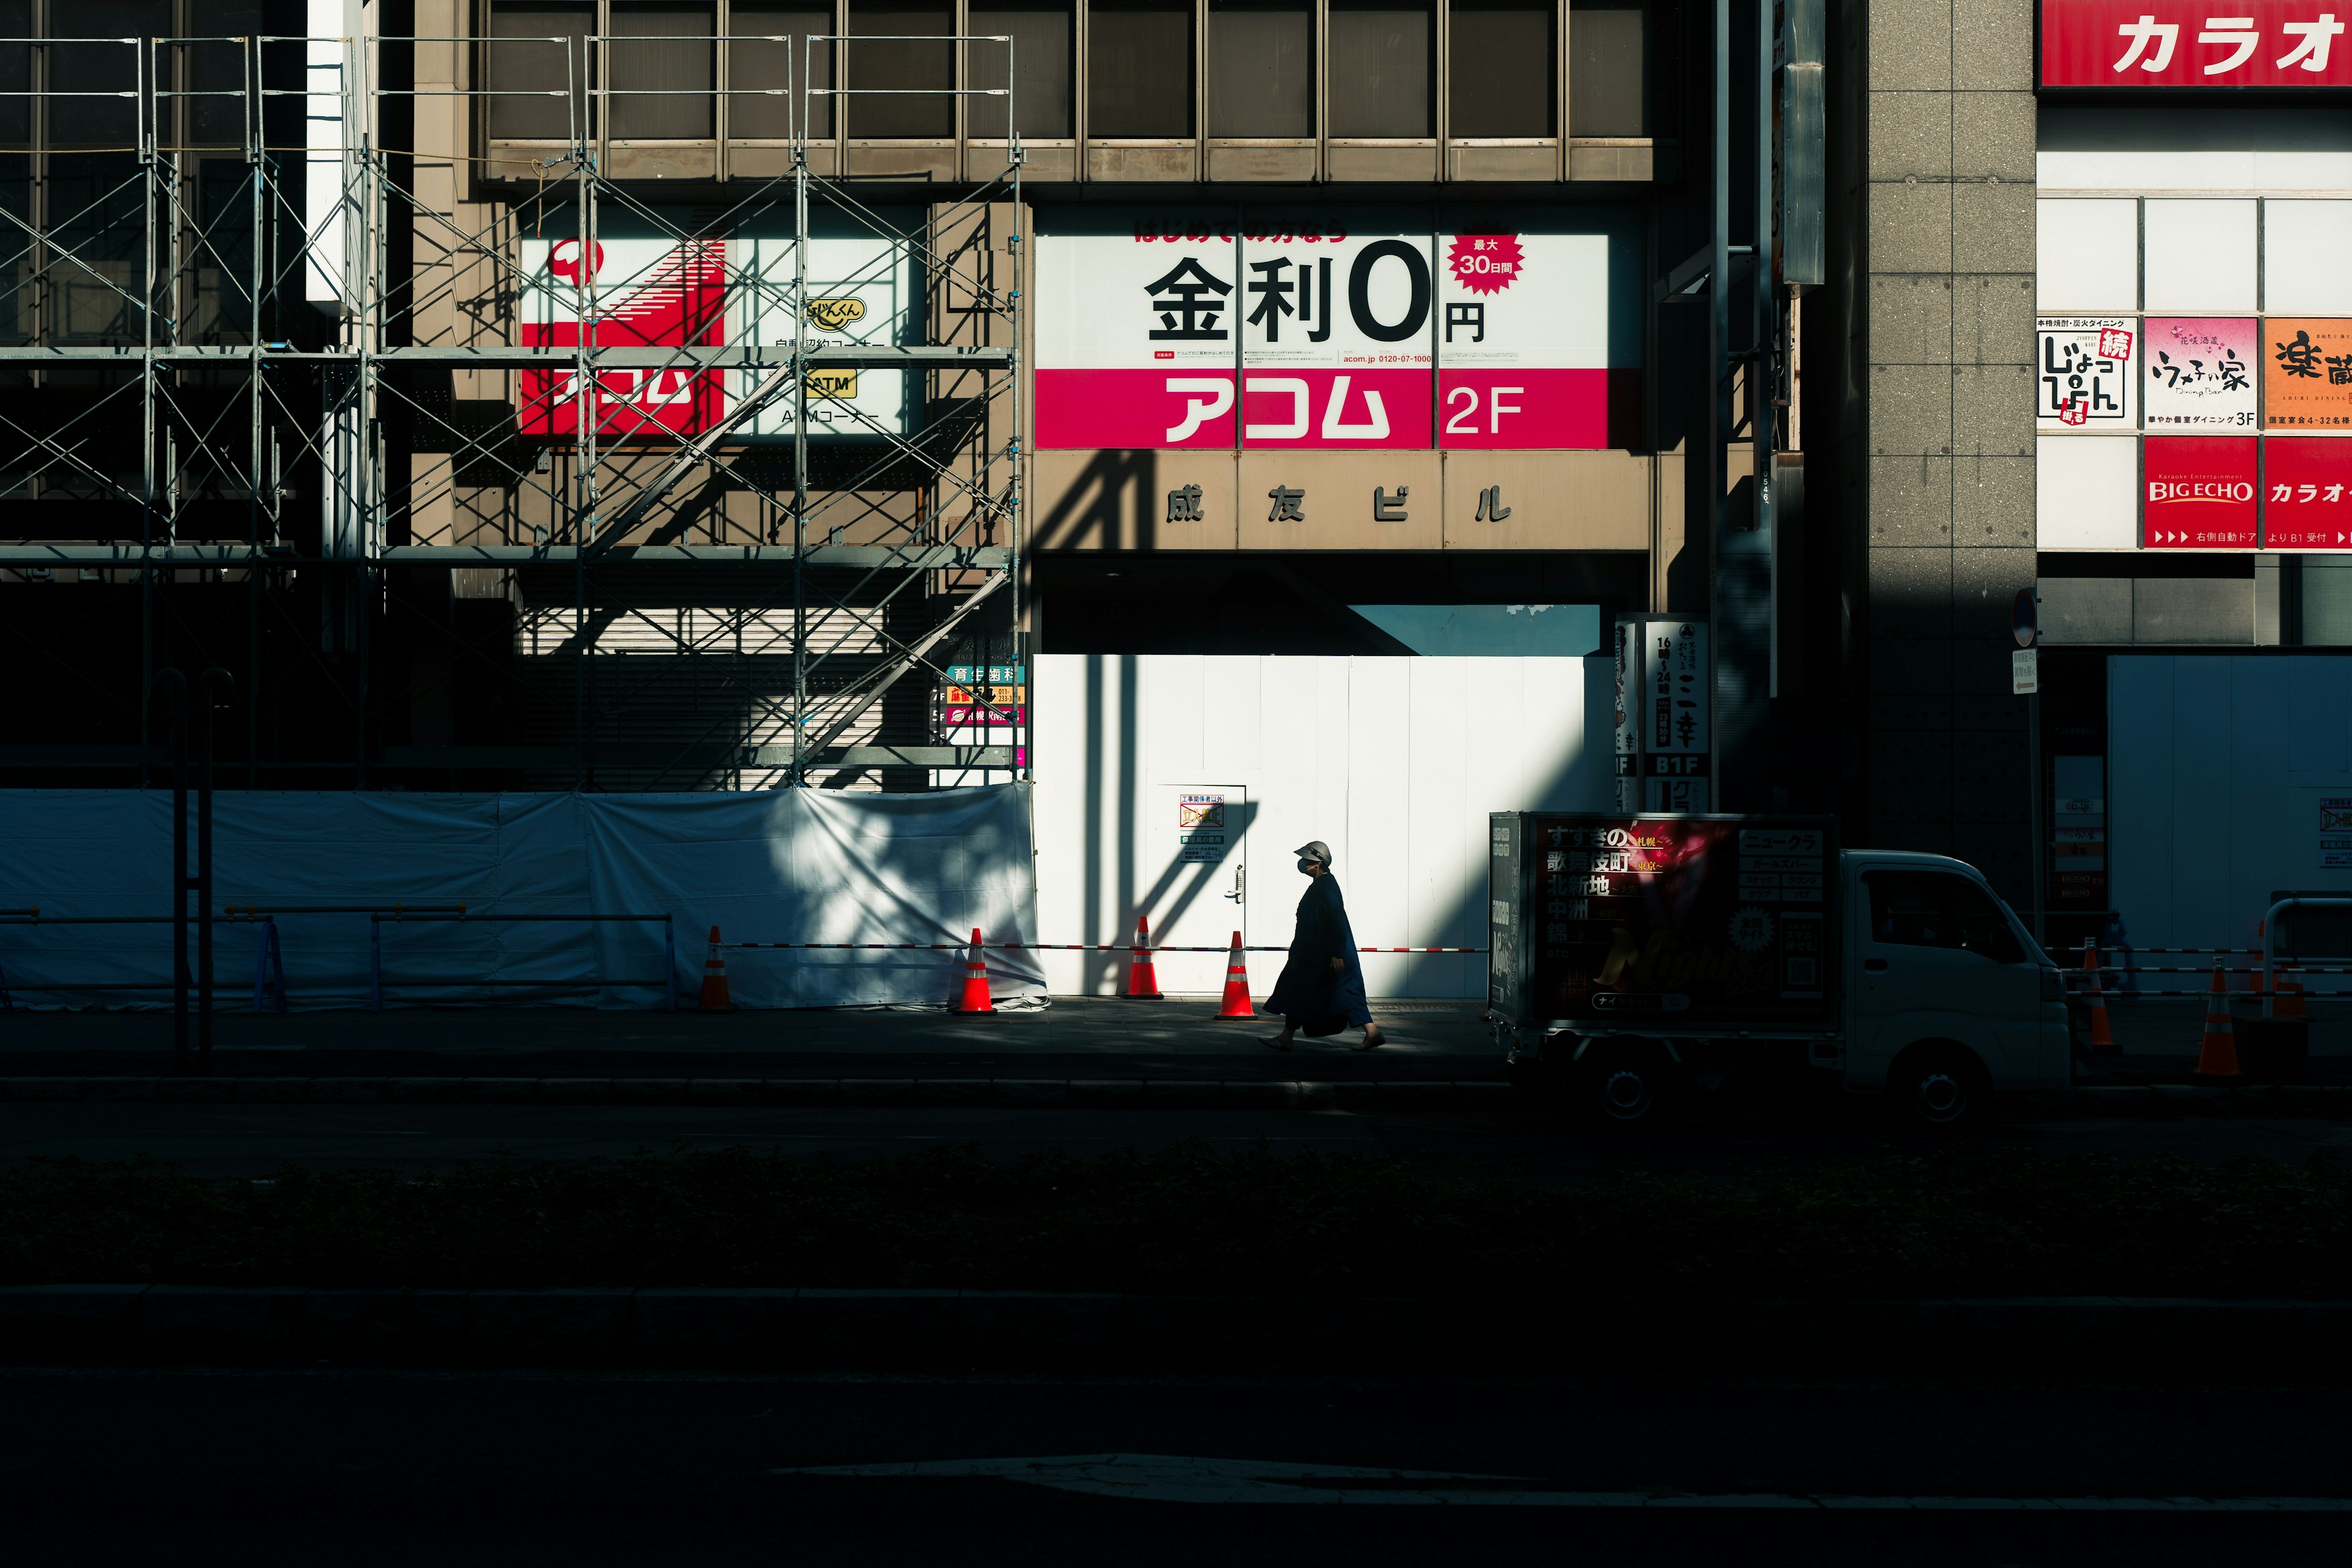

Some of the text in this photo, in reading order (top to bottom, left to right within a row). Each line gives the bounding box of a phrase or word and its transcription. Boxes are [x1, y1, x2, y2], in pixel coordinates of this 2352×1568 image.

[2113, 14, 2345, 75] カラオ
[1134, 219, 1347, 243] はじめての方なら
[1474, 239, 1498, 251] 最大
[1459, 256, 1513, 274] 30日間
[1144, 239, 1483, 342] 金利0円
[2101, 331, 2130, 358] 続
[2180, 336, 2218, 345] 花咲酒蔵
[1344, 355, 1376, 364] acom.jp
[811, 377, 849, 390] ATM
[2176, 387, 2204, 398] Dining
[782, 410, 878, 423] AMコーナー
[1166, 375, 1524, 443] アコム 2F
[2236, 412, 2255, 425] 3F
[2150, 481, 2253, 502] BIG ECHO
[2271, 483, 2352, 503] カラオ
[1166, 484, 1512, 524] 成友ビル
[2196, 532, 2256, 542] 右側自動ドア
[2268, 532, 2326, 543] より B1 受付
[954, 668, 1014, 682] 育生歯科
[1656, 756, 1698, 774] B1F
[1183, 808, 1221, 823] 立入禁止
[1547, 826, 1628, 847] すすきの
[1746, 834, 1817, 851] ニュークラ
[1547, 850, 1630, 872] 歌舞伎町
[1752, 859, 1809, 869] ガールズバー
[1547, 874, 1610, 896] 北新地
[1749, 890, 1771, 899] クラブ
[1547, 899, 1589, 919] 中洲
[1741, 919, 1762, 929] 全国
[1547, 922, 1568, 943] 錦
[1739, 929, 1765, 940] サイト
[1785, 930, 1819, 941] スマホで
[1593, 927, 1757, 987] Nights
[1598, 996, 1650, 1006] ナイツネット
